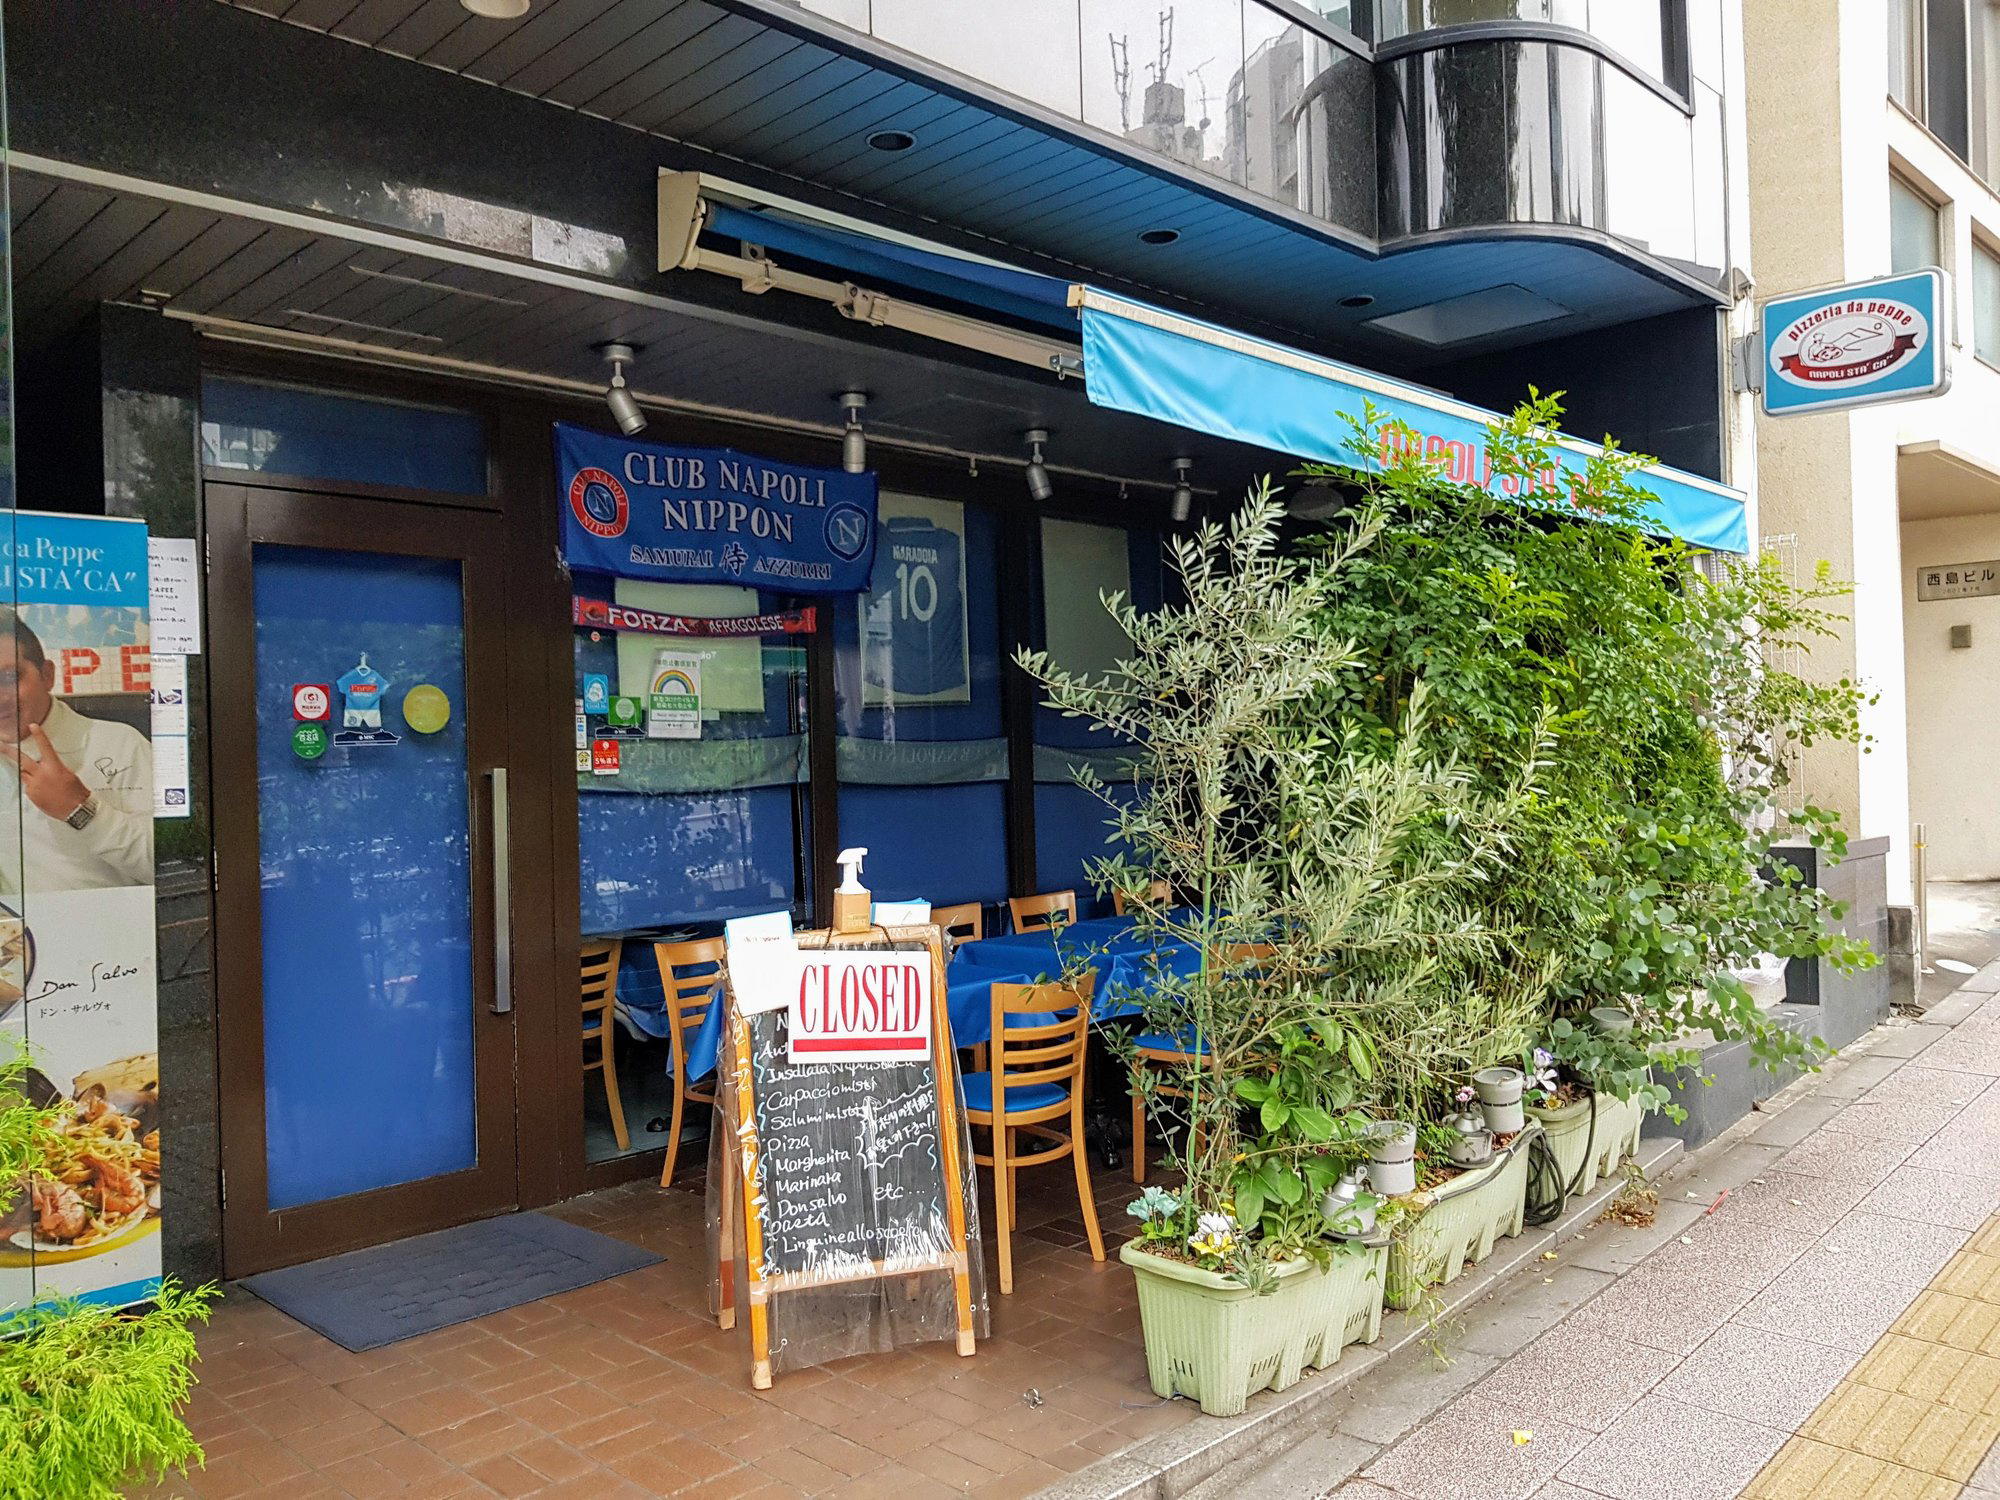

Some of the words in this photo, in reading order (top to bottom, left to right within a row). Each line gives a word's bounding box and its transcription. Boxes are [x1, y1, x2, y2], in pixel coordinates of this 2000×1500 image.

[1787, 306, 1842, 342] pizzeria
[1847, 301, 1863, 313] da
[1867, 301, 1913, 326] peppe
[1808, 370, 1844, 379] NAPOLI
[624, 452, 705, 490] CLUB
[718, 460, 827, 508] NAPOLI
[663, 499, 793, 543] NIPPON
[836, 517, 862, 546] N
[35, 537, 105, 567] Peppe
[630, 544, 713, 568] SAMURAI
[720, 541, 749, 576] 侍
[754, 557, 831, 580] AZZURRI
[1926, 568, 1995, 586] 西島ビル
[895, 563, 938, 622] 10
[607, 607, 691, 632] FORZA
[708, 615, 784, 633] AFRAGOLESE
[799, 964, 921, 1034] CLOSED
[775, 1148, 851, 1176] Margherita
[775, 1172, 841, 1196] Marinara
